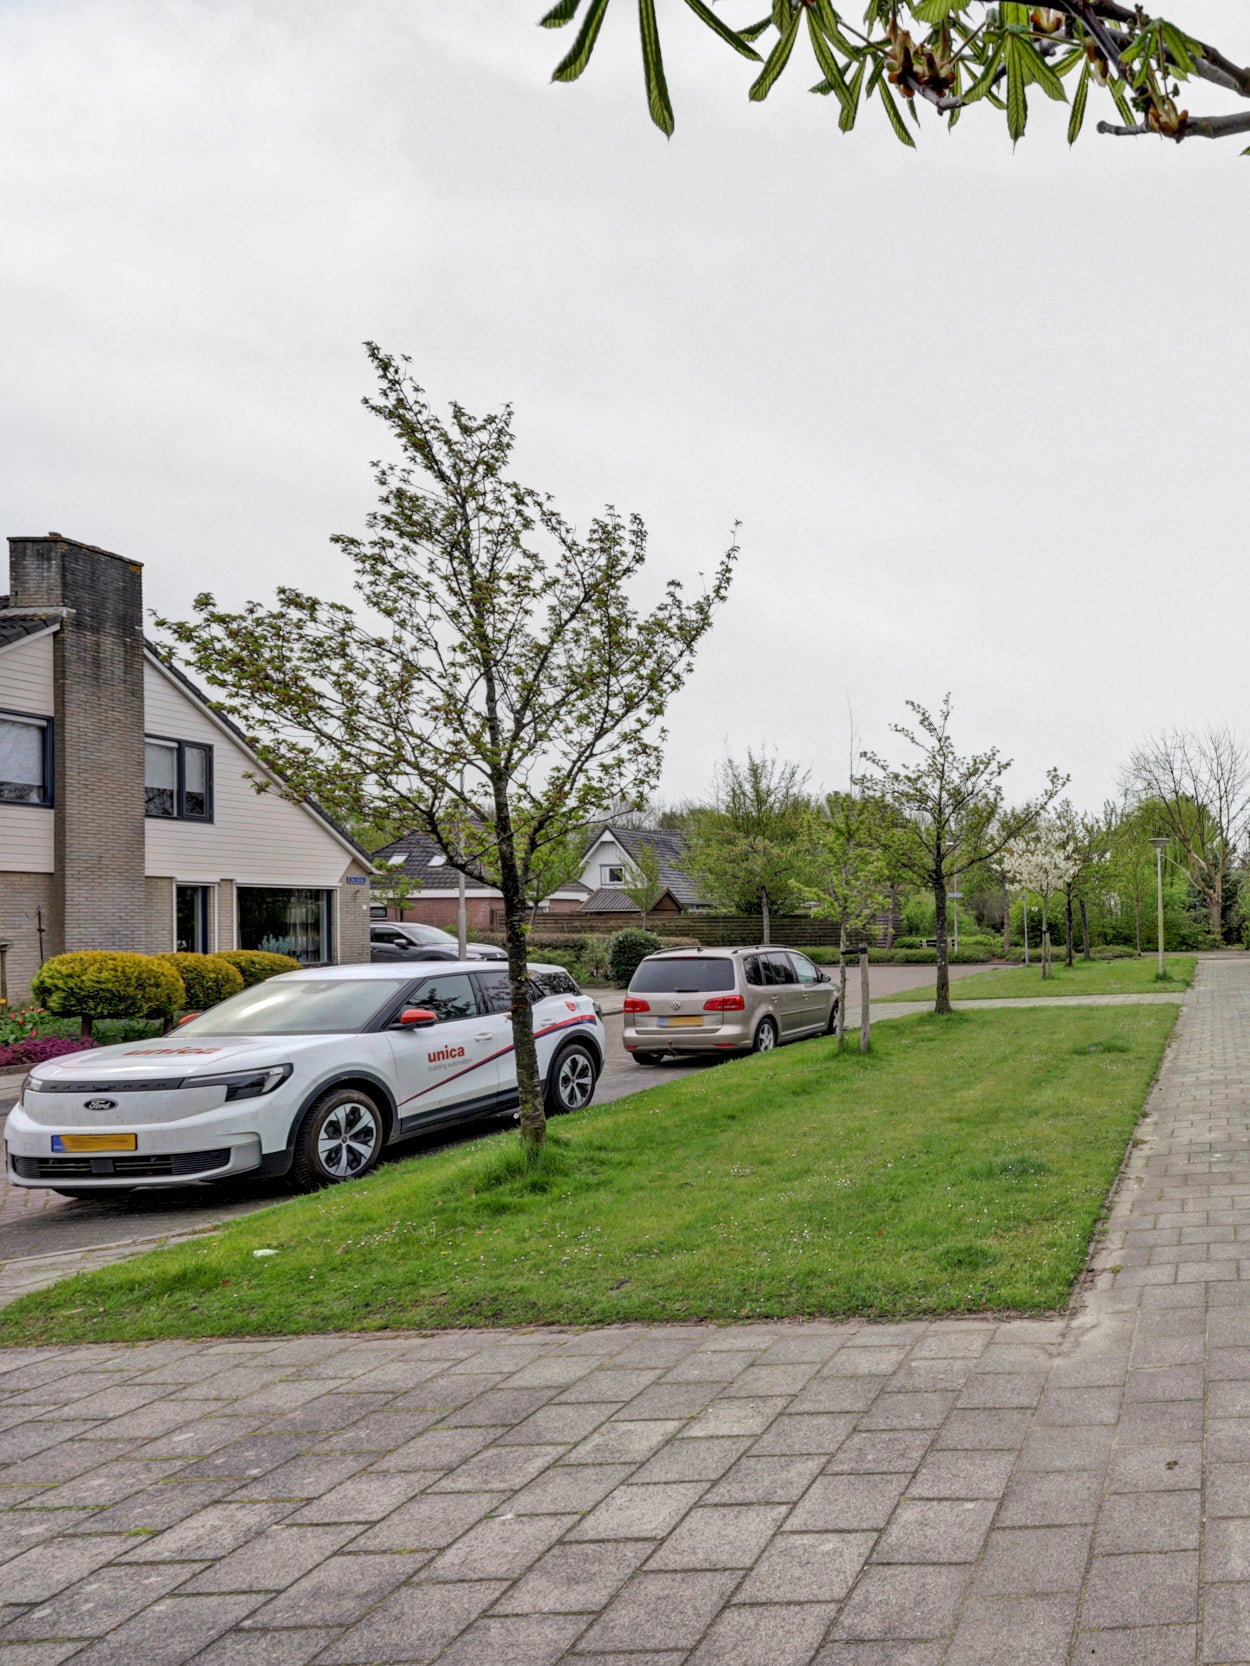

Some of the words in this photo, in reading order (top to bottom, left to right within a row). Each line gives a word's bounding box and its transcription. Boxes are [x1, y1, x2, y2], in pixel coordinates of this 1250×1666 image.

[122, 1046, 223, 1056] unica
[427, 1044, 465, 1063] unica
[88, 1100, 112, 1110] Ford
